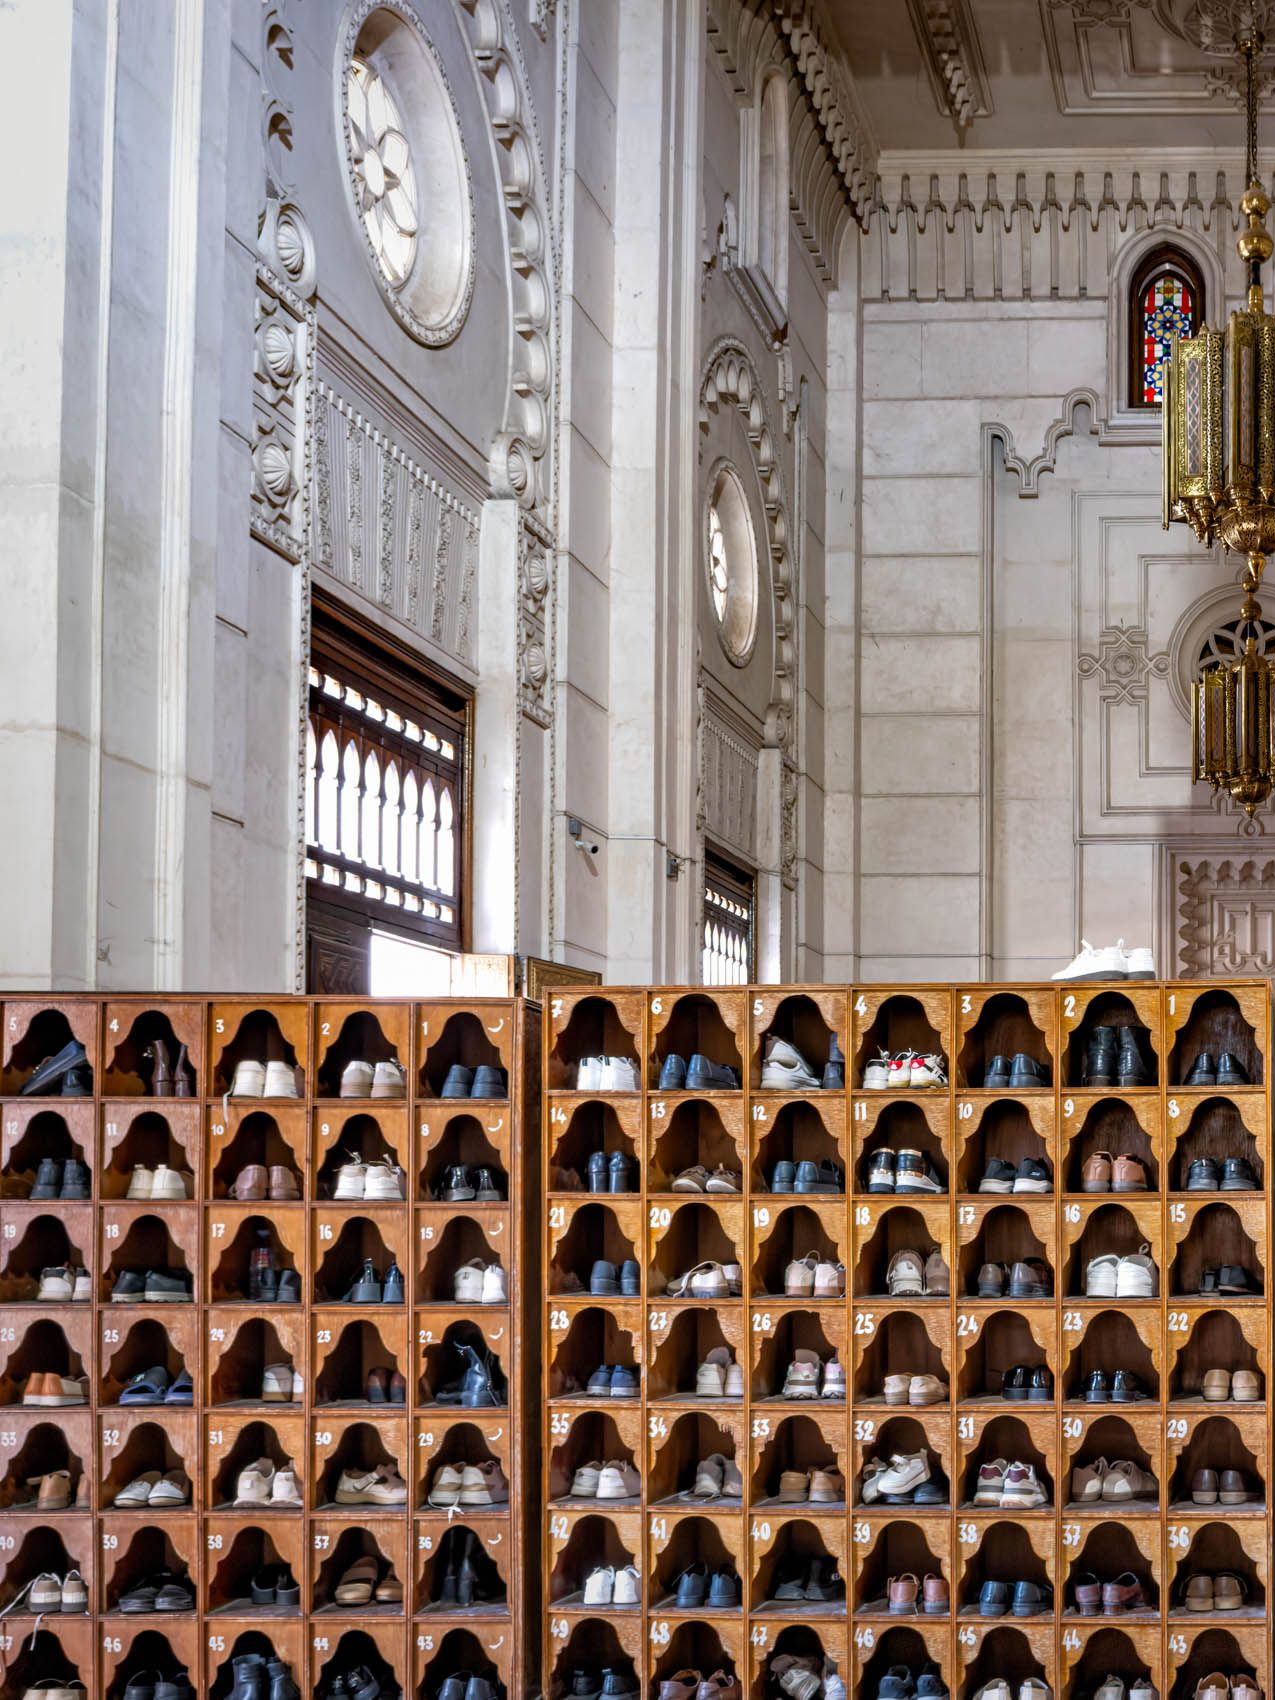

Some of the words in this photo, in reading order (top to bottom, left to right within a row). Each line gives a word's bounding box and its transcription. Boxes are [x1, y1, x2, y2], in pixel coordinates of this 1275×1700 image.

[551, 999, 564, 1018] 7
[651, 997, 663, 1015] 6
[753, 999, 765, 1016] 5
[854, 995, 868, 1017] 4
[961, 995, 972, 1014] 3
[1064, 995, 1076, 1018] 2
[1168, 994, 1176, 1016] 1
[9, 1016, 17, 1032] 5
[109, 1018, 120, 1033] 4
[215, 1018, 225, 1033] 3
[321, 1022, 331, 1036] 2
[421, 1021, 429, 1036] 1
[550, 1107, 568, 1125] 14
[650, 1101, 666, 1120] 13
[752, 1105, 768, 1121] 12
[854, 1102, 867, 1121] 11
[958, 1102, 973, 1120] 10
[1063, 1098, 1075, 1118] 9
[1168, 1099, 1181, 1119] 8
[211, 1123, 225, 1136] 10
[321, 1123, 330, 1136] 9
[421, 1123, 430, 1137] 8
[549, 1206, 565, 1228] 21
[650, 1207, 671, 1228] 20
[753, 1207, 770, 1228] 19
[855, 1206, 871, 1226] 18
[959, 1206, 976, 1225] 17
[1064, 1203, 1081, 1224] 16
[1170, 1203, 1187, 1223] 15
[105, 1223, 120, 1239] 18
[211, 1223, 225, 1238] 17
[319, 1224, 333, 1240] 16
[420, 1226, 434, 1240] 15
[550, 1310, 570, 1330] 28
[649, 1311, 668, 1331] 27
[752, 1313, 772, 1332] 26
[854, 1313, 875, 1335] 25
[957, 1314, 979, 1336] 24
[1063, 1311, 1083, 1331] 23
[1167, 1311, 1189, 1332] 22
[103, 1329, 119, 1343] 25
[209, 1327, 225, 1342] 24
[317, 1329, 331, 1344] 23
[419, 1329, 433, 1344] 22
[551, 1412, 570, 1435] 35
[649, 1416, 668, 1438] 34
[752, 1418, 770, 1438] 33
[855, 1420, 875, 1441] 32
[958, 1416, 975, 1439] 31
[1062, 1417, 1083, 1438] 30
[1167, 1419, 1188, 1439] 29
[103, 1429, 120, 1446] 32
[209, 1430, 223, 1445] 31
[315, 1431, 333, 1446] 30
[418, 1432, 434, 1447] 29
[550, 1515, 570, 1540] 42
[959, 1523, 978, 1544] 38
[1063, 1524, 1081, 1546] 37
[1167, 1526, 1190, 1548] 36
[103, 1534, 118, 1550] 39
[207, 1534, 223, 1550] 38
[314, 1535, 330, 1550] 37
[418, 1536, 433, 1550] 36
[650, 1620, 671, 1645] 48
[855, 1627, 875, 1648] 46
[1062, 1629, 1082, 1652] 44
[103, 1636, 122, 1653] 46
[208, 1635, 225, 1652] 45
[417, 1635, 434, 1651] 43
[1168, 1634, 1187, 1654] 43
